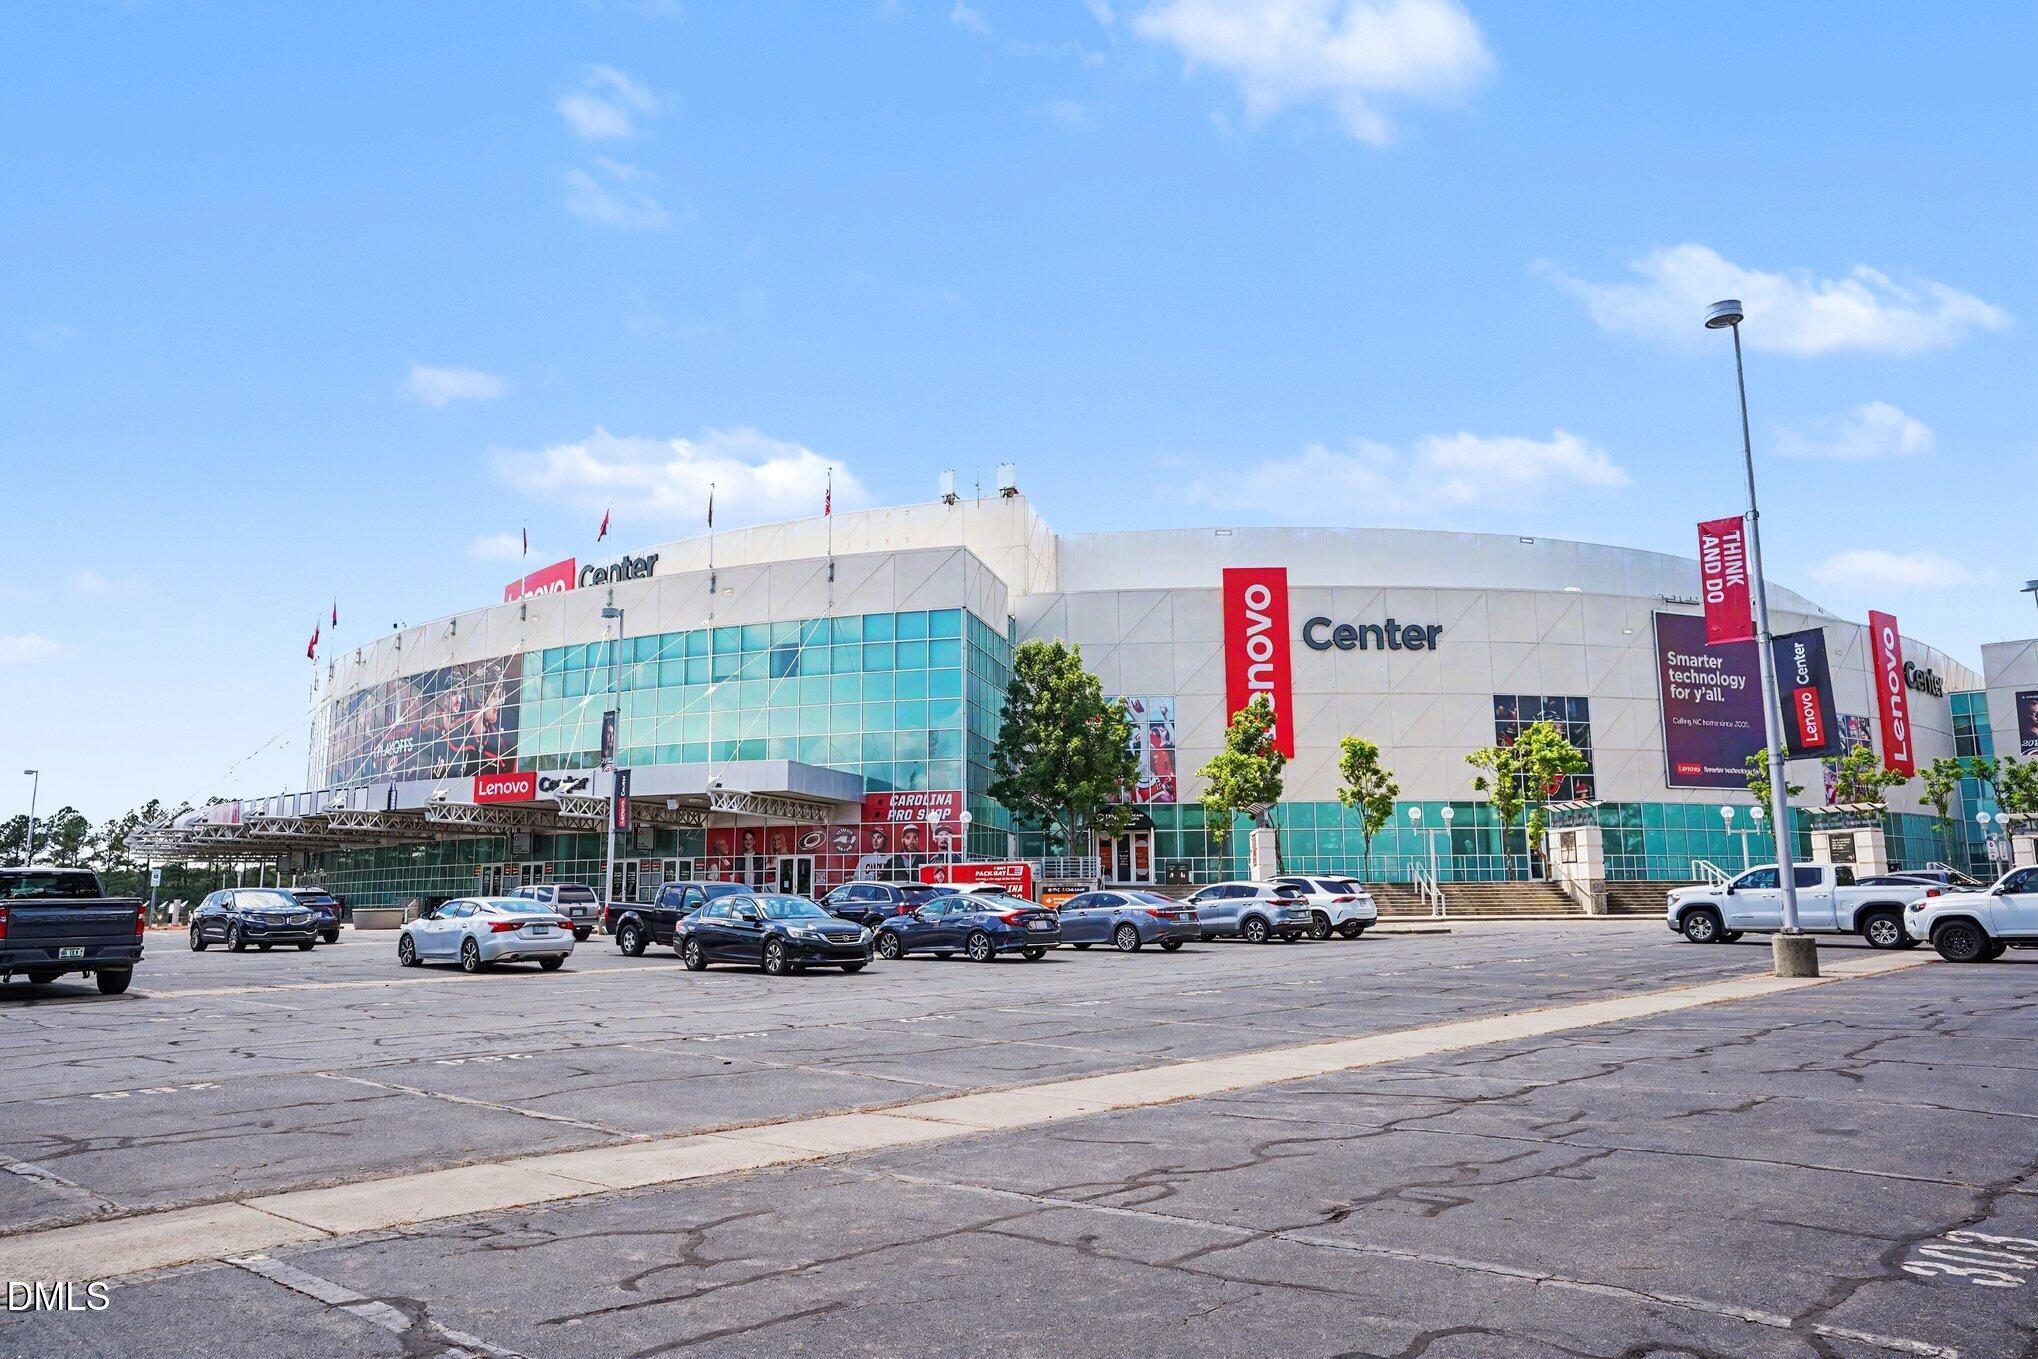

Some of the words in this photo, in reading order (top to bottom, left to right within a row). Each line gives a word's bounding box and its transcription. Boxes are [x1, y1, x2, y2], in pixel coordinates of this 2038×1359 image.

[1702, 533, 1722, 574] AND
[1722, 529, 1745, 587] THINK
[509, 579, 566, 602] novo
[578, 553, 659, 588] Center
[1706, 578, 1725, 604] DO
[1244, 583, 1278, 741] novo
[1303, 616, 1443, 651] Center
[1667, 651, 1723, 669] Smarter
[1793, 642, 1810, 685] Center
[1669, 669, 1746, 690] technology
[1670, 685, 1690, 700] for
[1694, 686, 1726, 703] y'all.
[1883, 626, 1908, 762] Lenovo
[1903, 660, 1944, 698] Center
[1672, 717, 1692, 727] Calling
[1692, 718, 1702, 726] NC
[1702, 719, 1718, 727] home
[1719, 720, 1733, 728] since
[1801, 692, 1819, 742] Lenovo
[478, 780, 529, 796] Lenovo
[889, 793, 953, 807] CAROLINA
[887, 809, 913, 821] PRO
[916, 808, 952, 821] SOP
